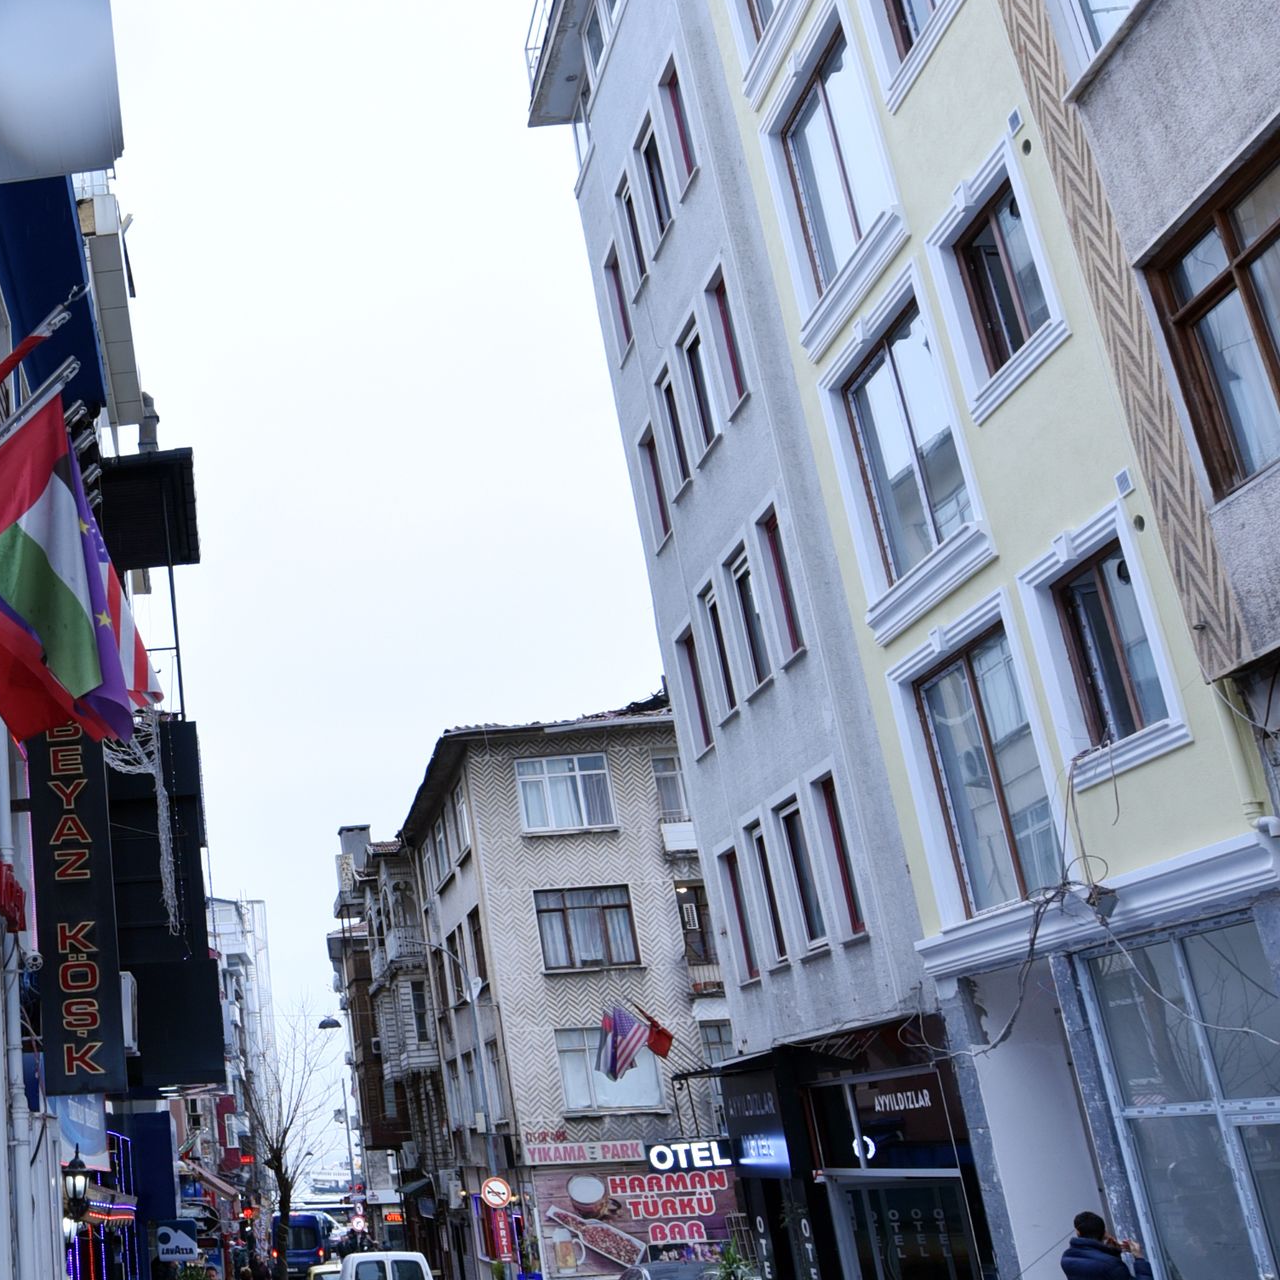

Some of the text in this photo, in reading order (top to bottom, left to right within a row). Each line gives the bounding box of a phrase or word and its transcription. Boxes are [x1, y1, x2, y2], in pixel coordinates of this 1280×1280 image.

[57, 921, 106, 1075] KÖŞK
[874, 1088, 932, 1113] AYYILDIZLAR
[527, 1145, 587, 1163] YIKAMA
[601, 1142, 641, 1160] PARK
[649, 1141, 732, 1170] OTEL
[607, 1170, 728, 1196] HARMAN
[626, 1191, 716, 1219] TÜRKÜ
[648, 1220, 707, 1244] BAR
[888, 1209, 907, 1259] OTEL
[911, 1208, 930, 1257] OTEL
[933, 1208, 952, 1258] OTEL
[161, 1245, 194, 1255] LAVAZZA
